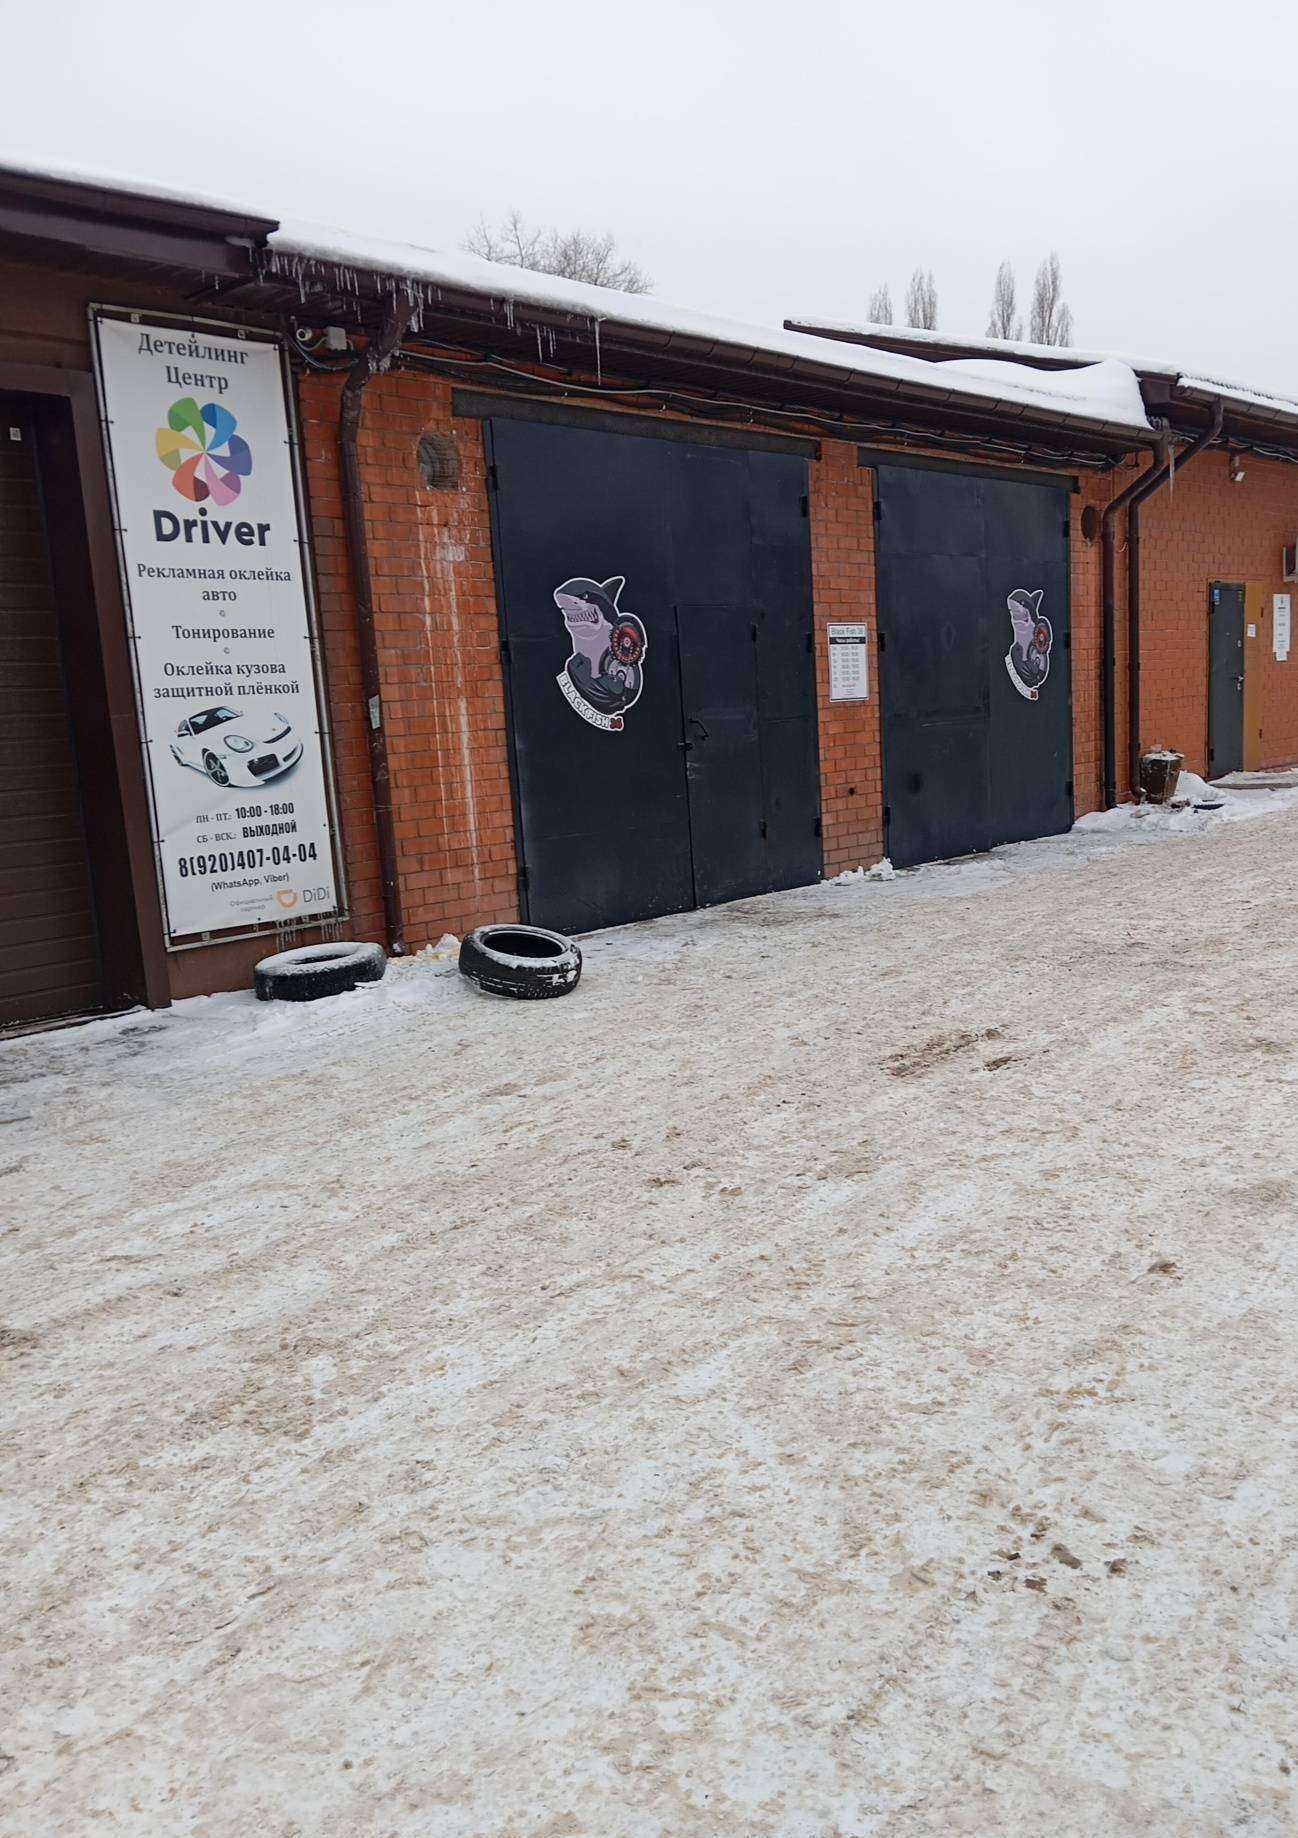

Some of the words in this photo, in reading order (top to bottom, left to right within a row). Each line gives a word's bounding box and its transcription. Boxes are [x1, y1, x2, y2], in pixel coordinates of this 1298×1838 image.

[138, 333, 248, 365] Детейлинг
[165, 365, 229, 394] Центр
[152, 507, 271, 547] Driver
[137, 563, 225, 580] Рекламная
[229, 567, 291, 582] оклейка
[202, 590, 237, 602] авто
[171, 625, 275, 642] Тонирование
[164, 661, 232, 677] Оклейка
[236, 662, 286, 678] кузова
[153, 682, 233, 699] защитной
[238, 680, 300, 696] плёнкой
[235, 805, 262, 819] 10:00
[269, 802, 294, 816] 18:00
[196, 834, 208, 843] СБ
[242, 819, 297, 839] ВЫХОДНОЙ
[211, 877, 262, 892] (WhatsApp,
[264, 872, 289, 884] Viber)
[303, 887, 330, 903] DiDi
